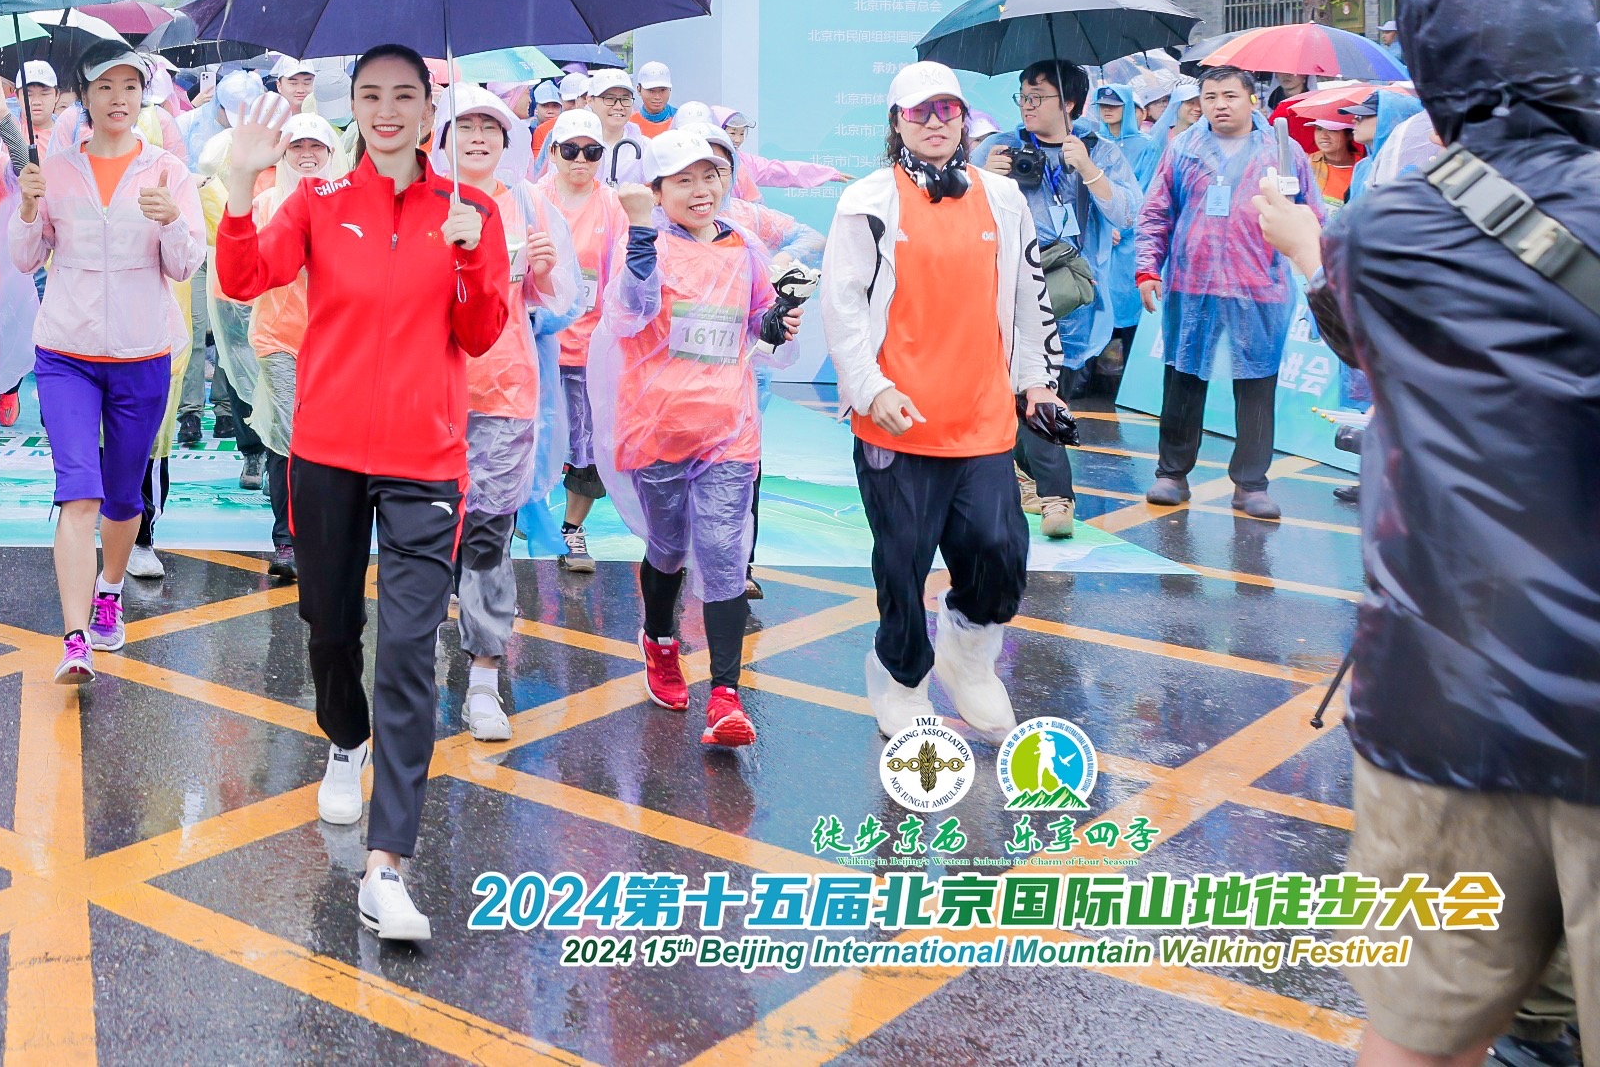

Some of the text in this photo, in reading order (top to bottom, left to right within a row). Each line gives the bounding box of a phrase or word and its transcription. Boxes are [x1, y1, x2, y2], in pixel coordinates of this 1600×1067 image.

[853, 0, 943, 13] 北京市体育总会
[807, 29, 925, 43] 北京市民间组织国际
[834, 92, 888, 106] 北京市体
[834, 123, 888, 137] 北京市门
[314, 178, 351, 196] CHINA
